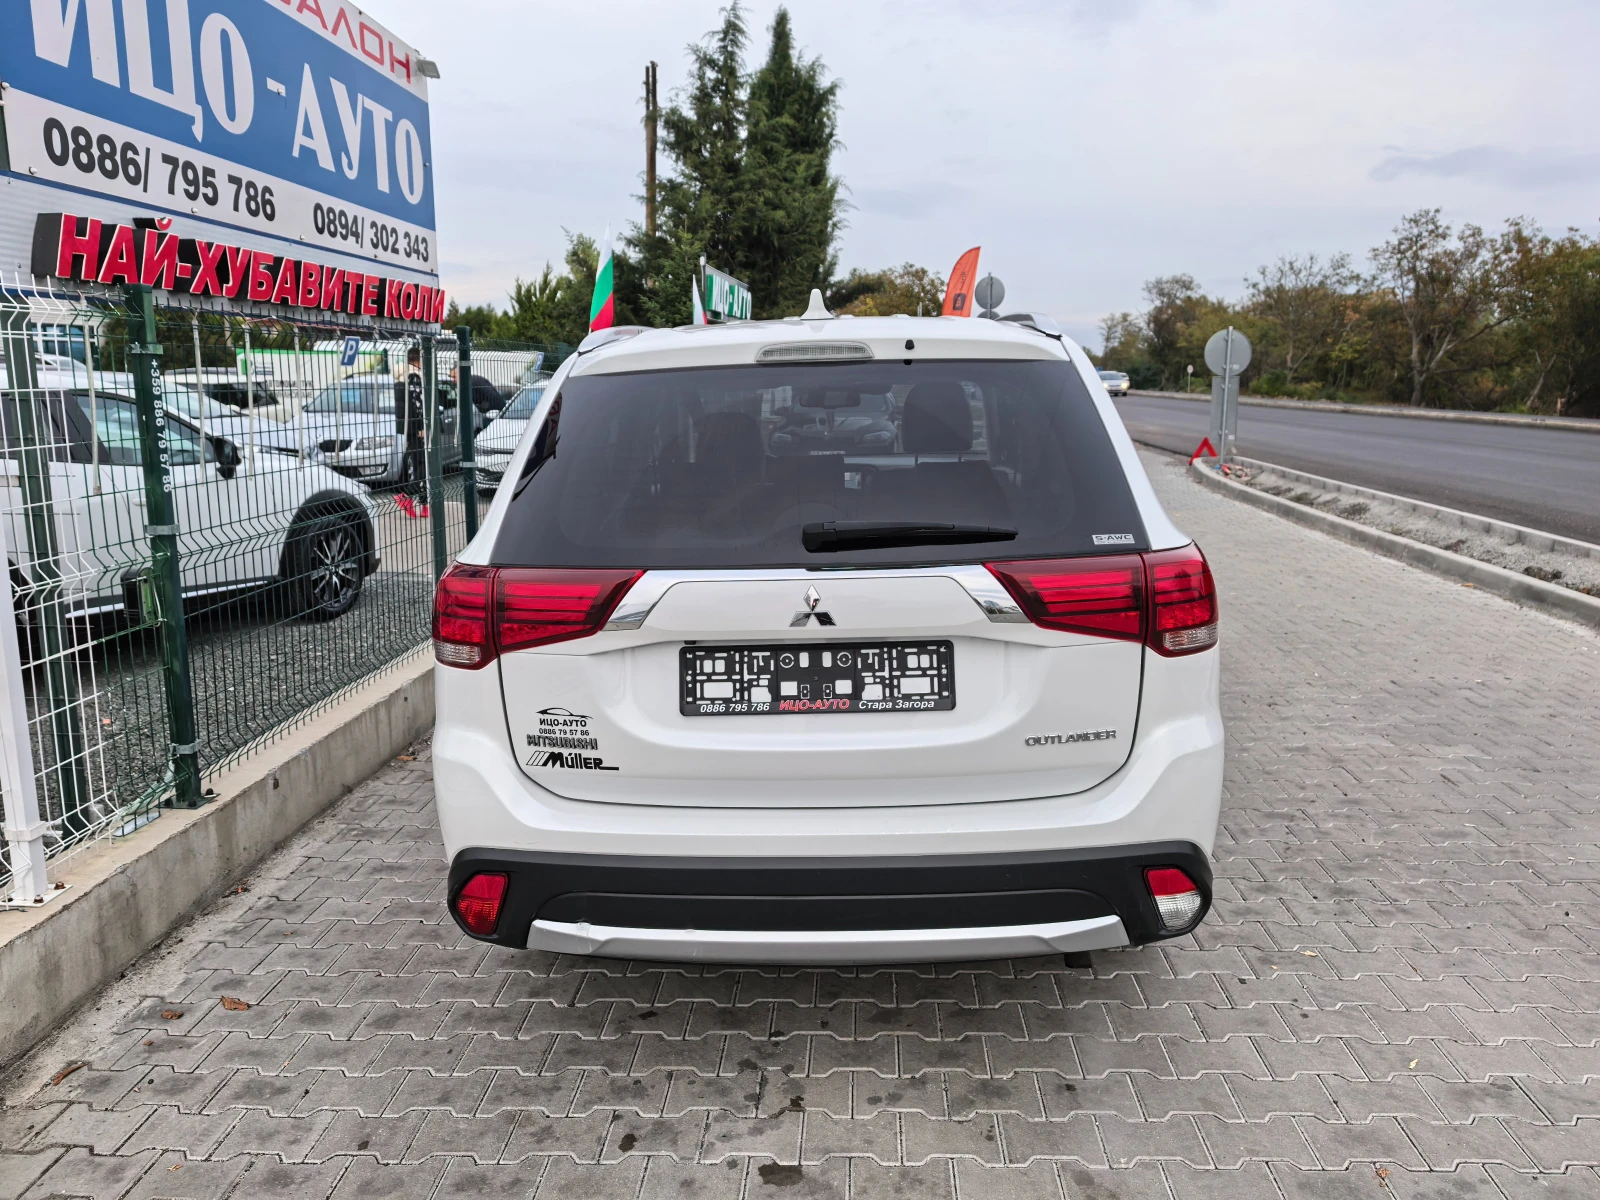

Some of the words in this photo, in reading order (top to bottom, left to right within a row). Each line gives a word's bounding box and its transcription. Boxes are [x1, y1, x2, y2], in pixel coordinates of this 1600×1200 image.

[278, 0, 411, 84] АЛОН
[43, 117, 151, 193] 0886/
[161, 152, 219, 206] 795
[227, 173, 276, 222] 786
[313, 202, 365, 249] 0894/
[370, 220, 399, 255] 302
[403, 231, 429, 262] 343
[55, 213, 380, 316] НАЙ-ХУБАВИТЕ
[384, 277, 446, 324] КОЛИ
[344, 340, 356, 363] P
[151, 358, 162, 395] +359
[154, 399, 165, 427] 886
[157, 430, 167, 449] 79
[160, 453, 170, 470] 57
[162, 474, 172, 493] 86
[700, 703, 726, 713] 0886
[729, 703, 748, 713] 795
[751, 702, 770, 712] 786
[779, 699, 850, 712] ИЦО-АУТО
[858, 700, 893, 710] Стара
[895, 699, 935, 710] Загора
[539, 718, 587, 727] ИЦО-АУТО
[526, 734, 598, 750] MITSUBISHI
[1025, 728, 1117, 747] OUTLANDER
